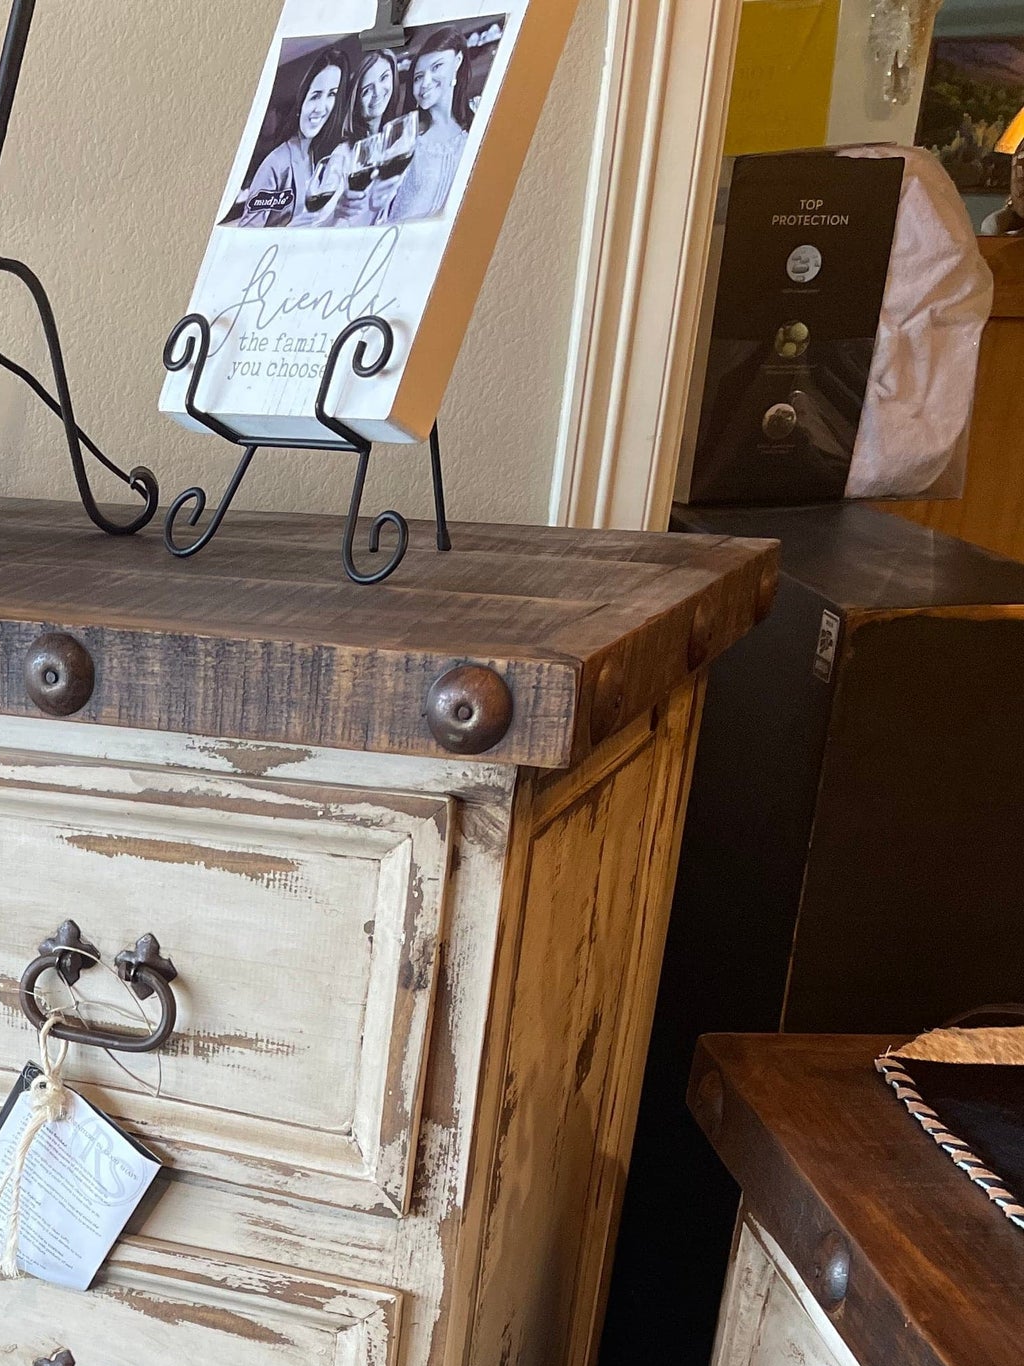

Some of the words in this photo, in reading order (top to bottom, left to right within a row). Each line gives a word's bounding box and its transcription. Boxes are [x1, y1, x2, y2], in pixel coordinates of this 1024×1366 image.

[799, 199, 824, 211] TOP
[771, 214, 849, 226] PROTECTION
[239, 332, 269, 352] the
[227, 360, 262, 380] you
